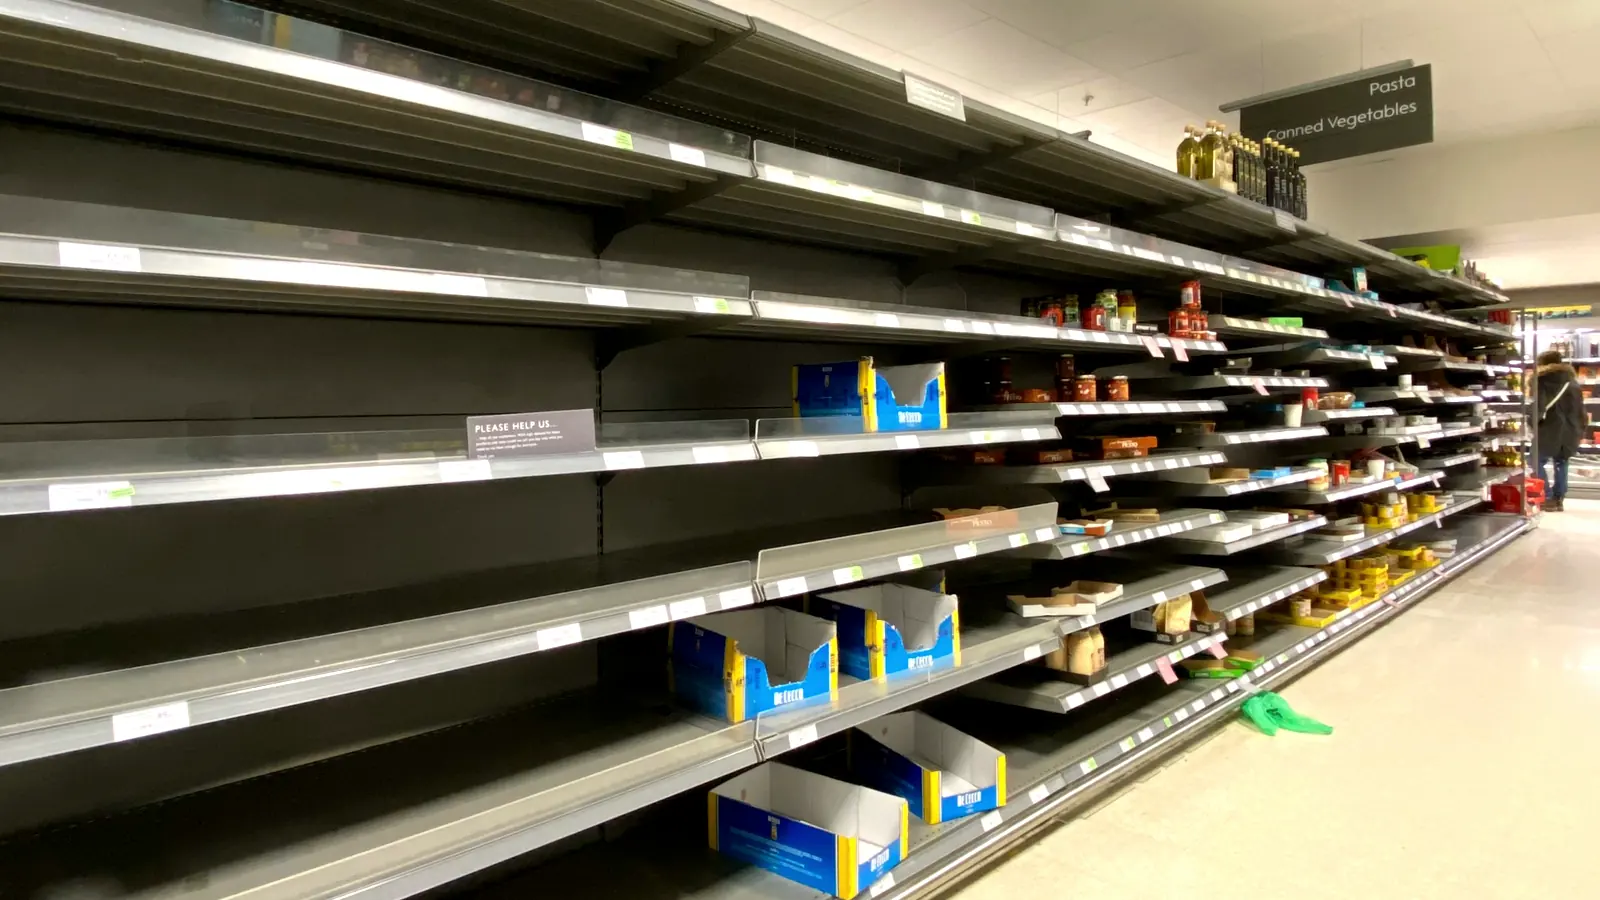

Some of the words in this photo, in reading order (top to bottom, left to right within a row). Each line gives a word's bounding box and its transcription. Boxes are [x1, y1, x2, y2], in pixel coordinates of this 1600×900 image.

[1369, 76, 1416, 96] Pasta
[1266, 119, 1324, 141] Canned
[1327, 102, 1417, 130] Vegetables
[475, 423, 509, 433] PLEASE
[512, 421, 536, 430] HELP
